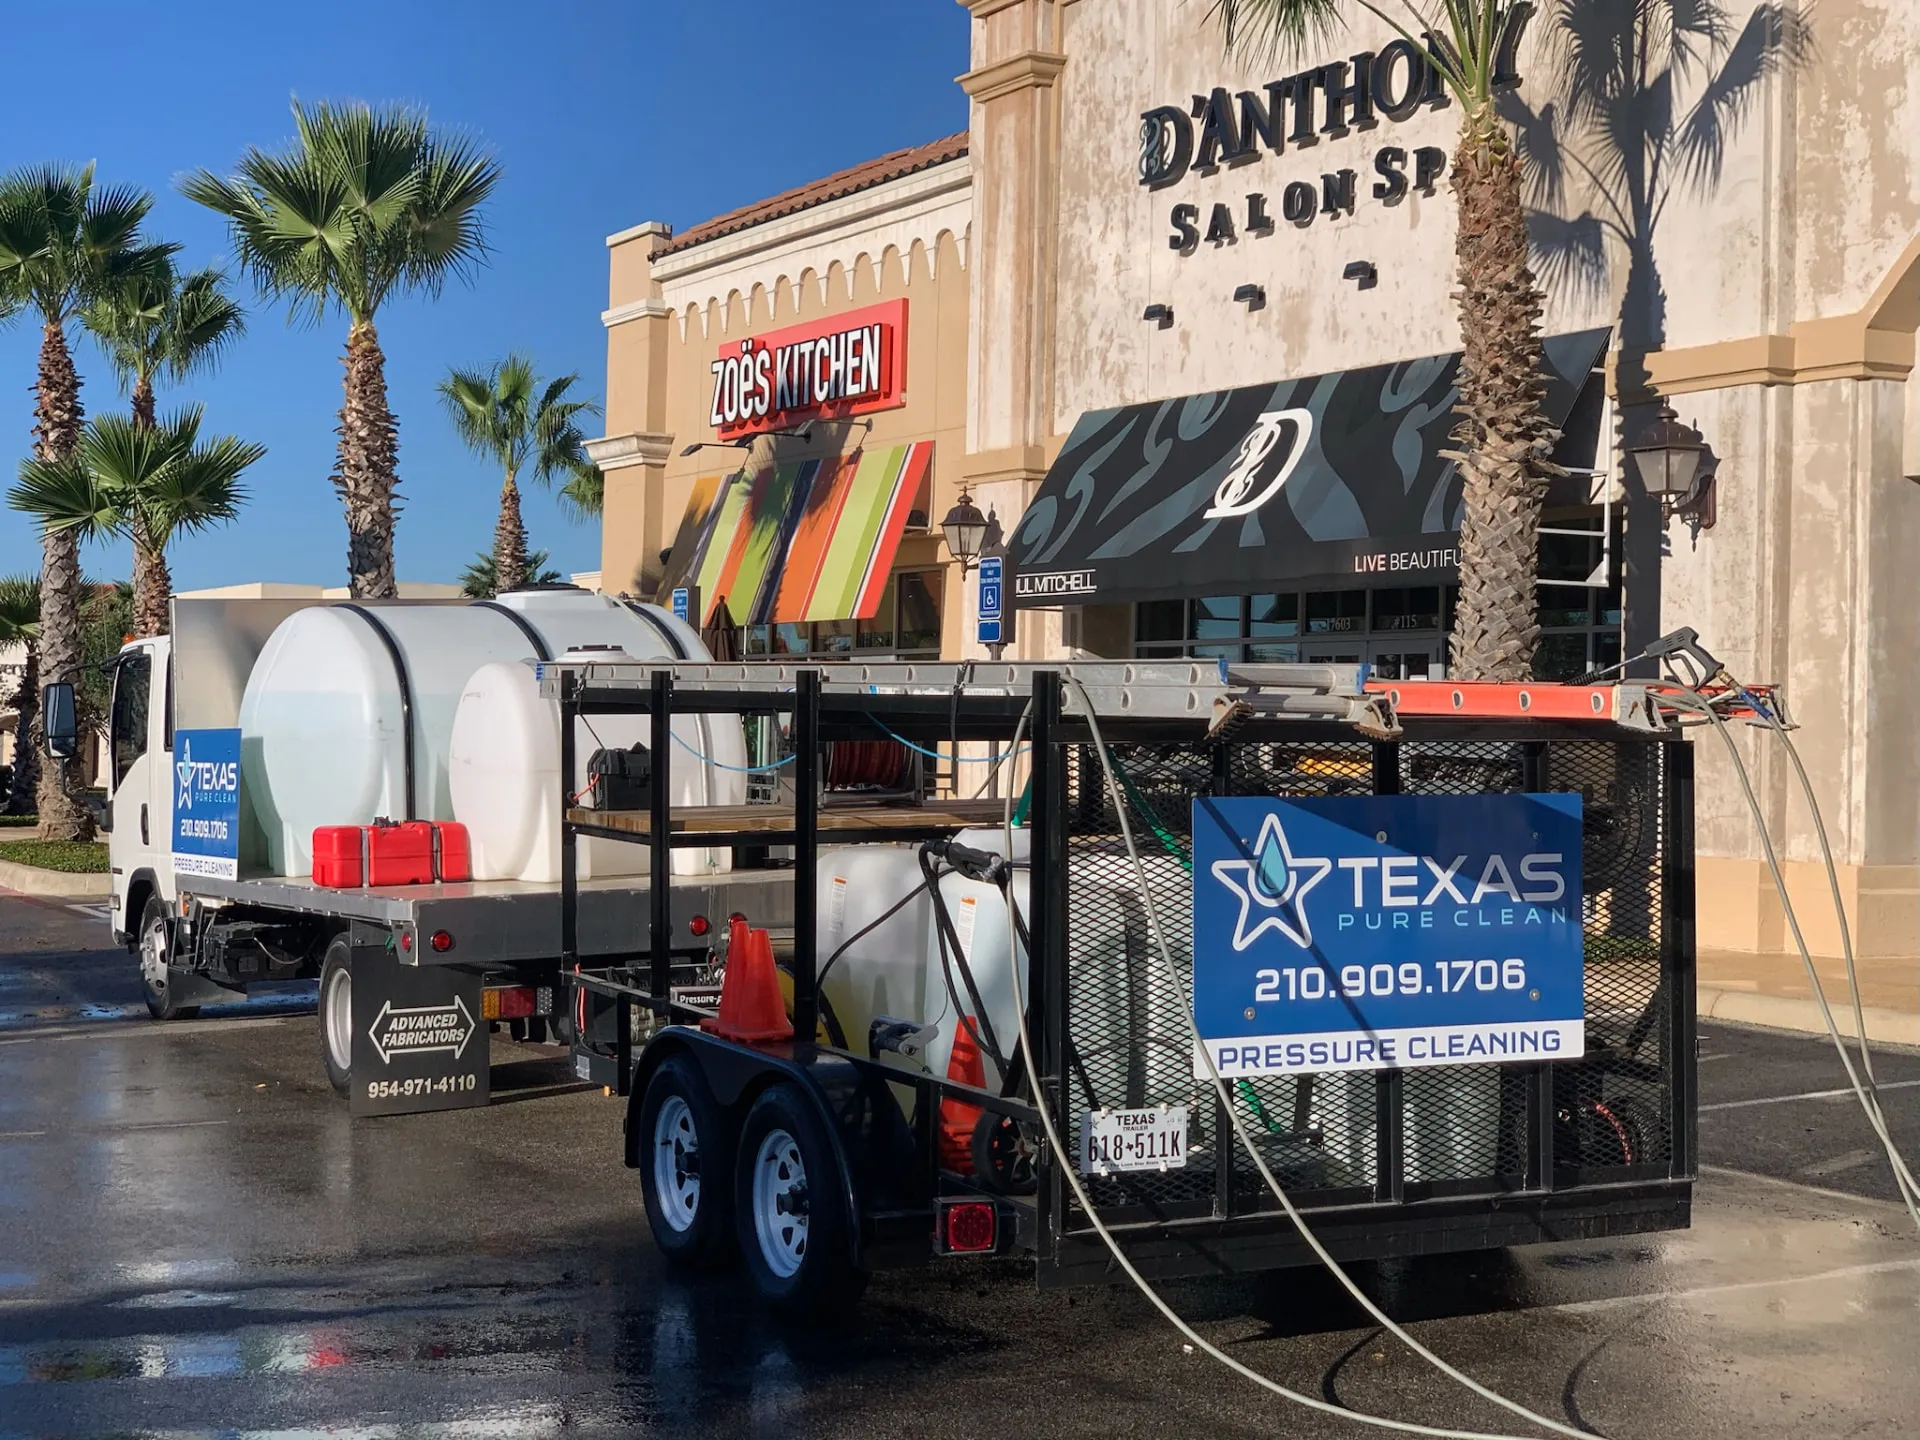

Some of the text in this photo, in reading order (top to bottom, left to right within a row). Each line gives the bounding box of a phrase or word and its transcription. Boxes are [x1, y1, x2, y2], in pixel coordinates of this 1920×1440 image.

[1169, 147, 1446, 255] SALON SP
[775, 323, 881, 410] KITCHEN
[1355, 549, 1463, 572] LIVE BEAUTIFU
[197, 762, 237, 790] TEXAS
[195, 792, 237, 804] PURE CLEAN
[181, 818, 228, 840] 210.909.1706
[1337, 853, 1565, 907] TEXAS
[1338, 907, 1566, 931] PURE CLEAN
[1255, 958, 1526, 1001] 210.909.1706
[388, 1013, 458, 1031] ADVANCED
[381, 1028, 465, 1047] FABRICATORS
[1218, 1029, 1561, 1071] PRESSURE CLEANING
[368, 1073, 476, 1099] 954-971-4110
[1115, 1113, 1156, 1126] TEXAS
